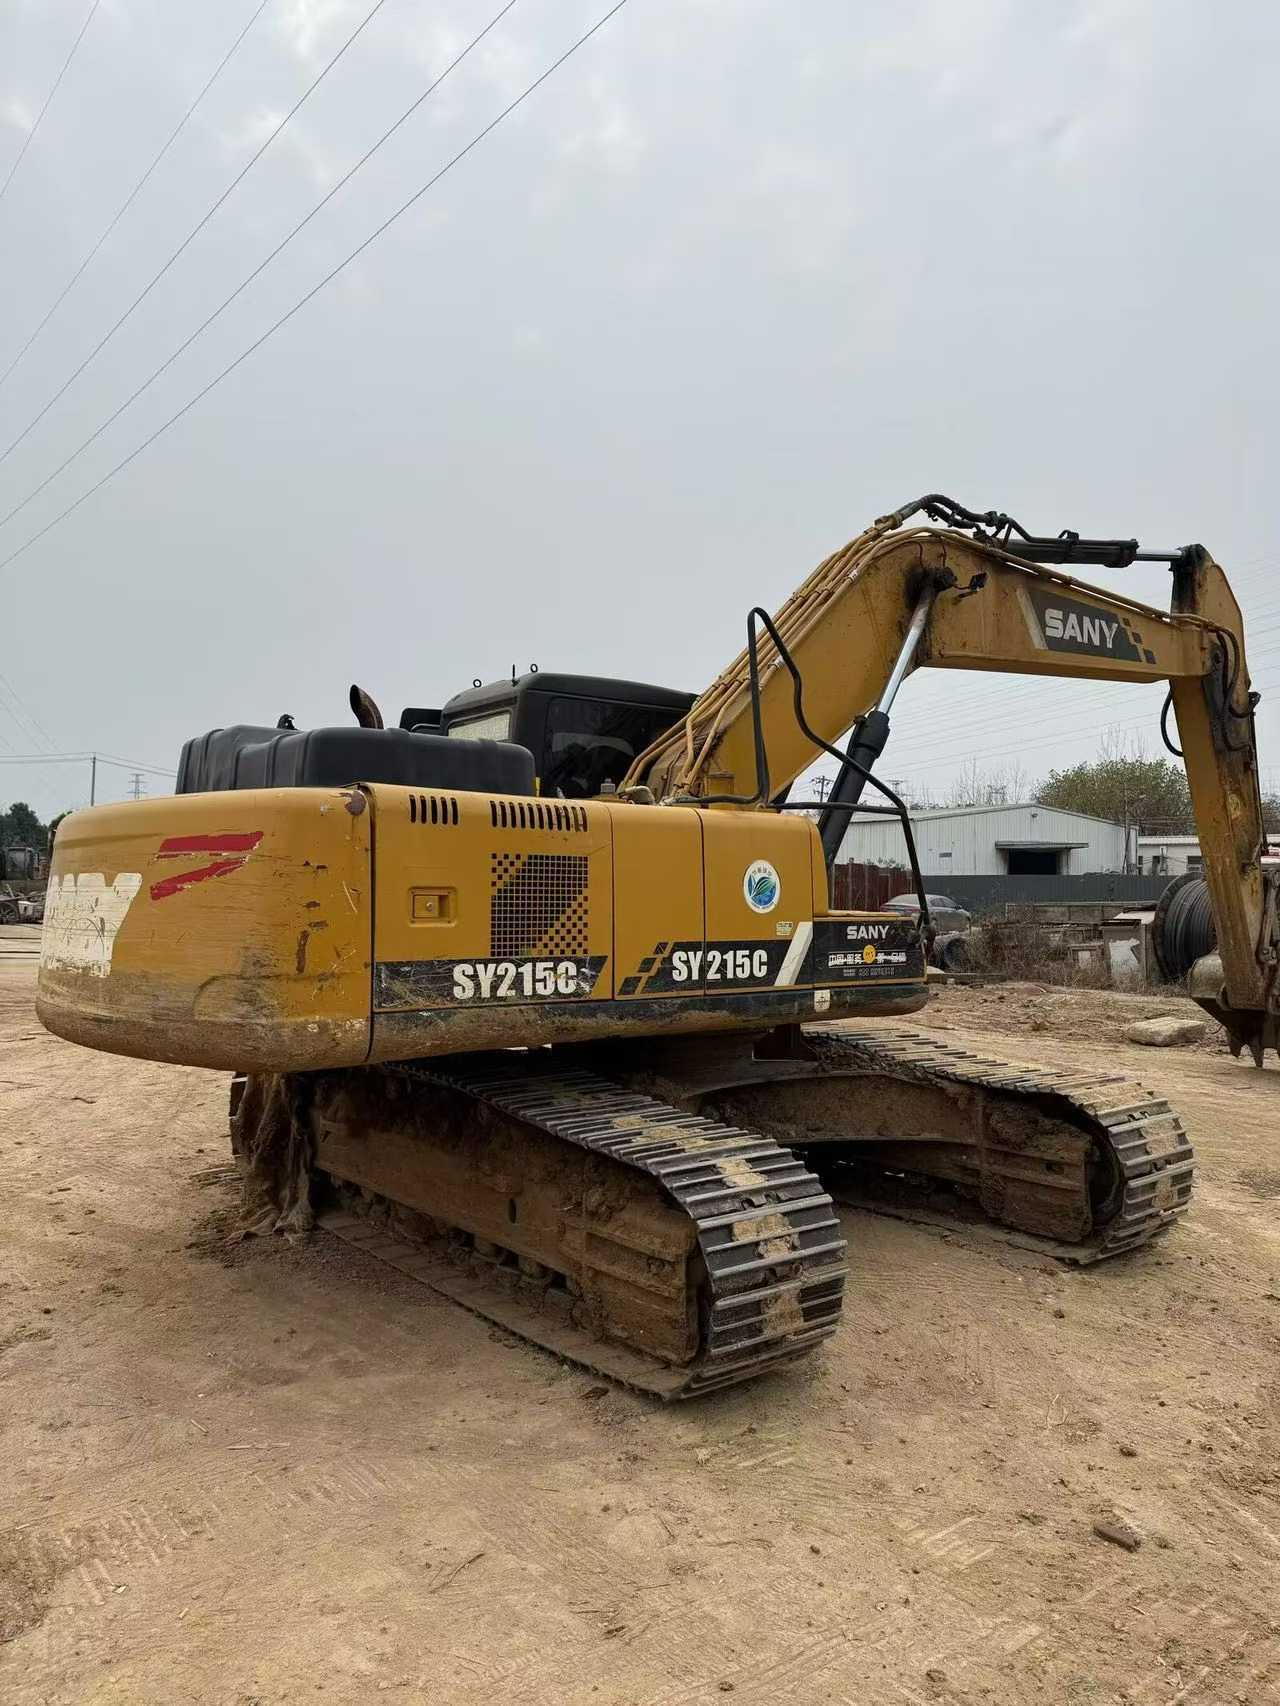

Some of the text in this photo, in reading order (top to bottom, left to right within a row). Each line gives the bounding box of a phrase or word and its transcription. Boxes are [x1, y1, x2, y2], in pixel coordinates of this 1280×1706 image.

[1045, 608, 1118, 649] SANY
[846, 925, 889, 940] SANY
[453, 961, 577, 1000] SY215C
[672, 950, 768, 981] SY215C
